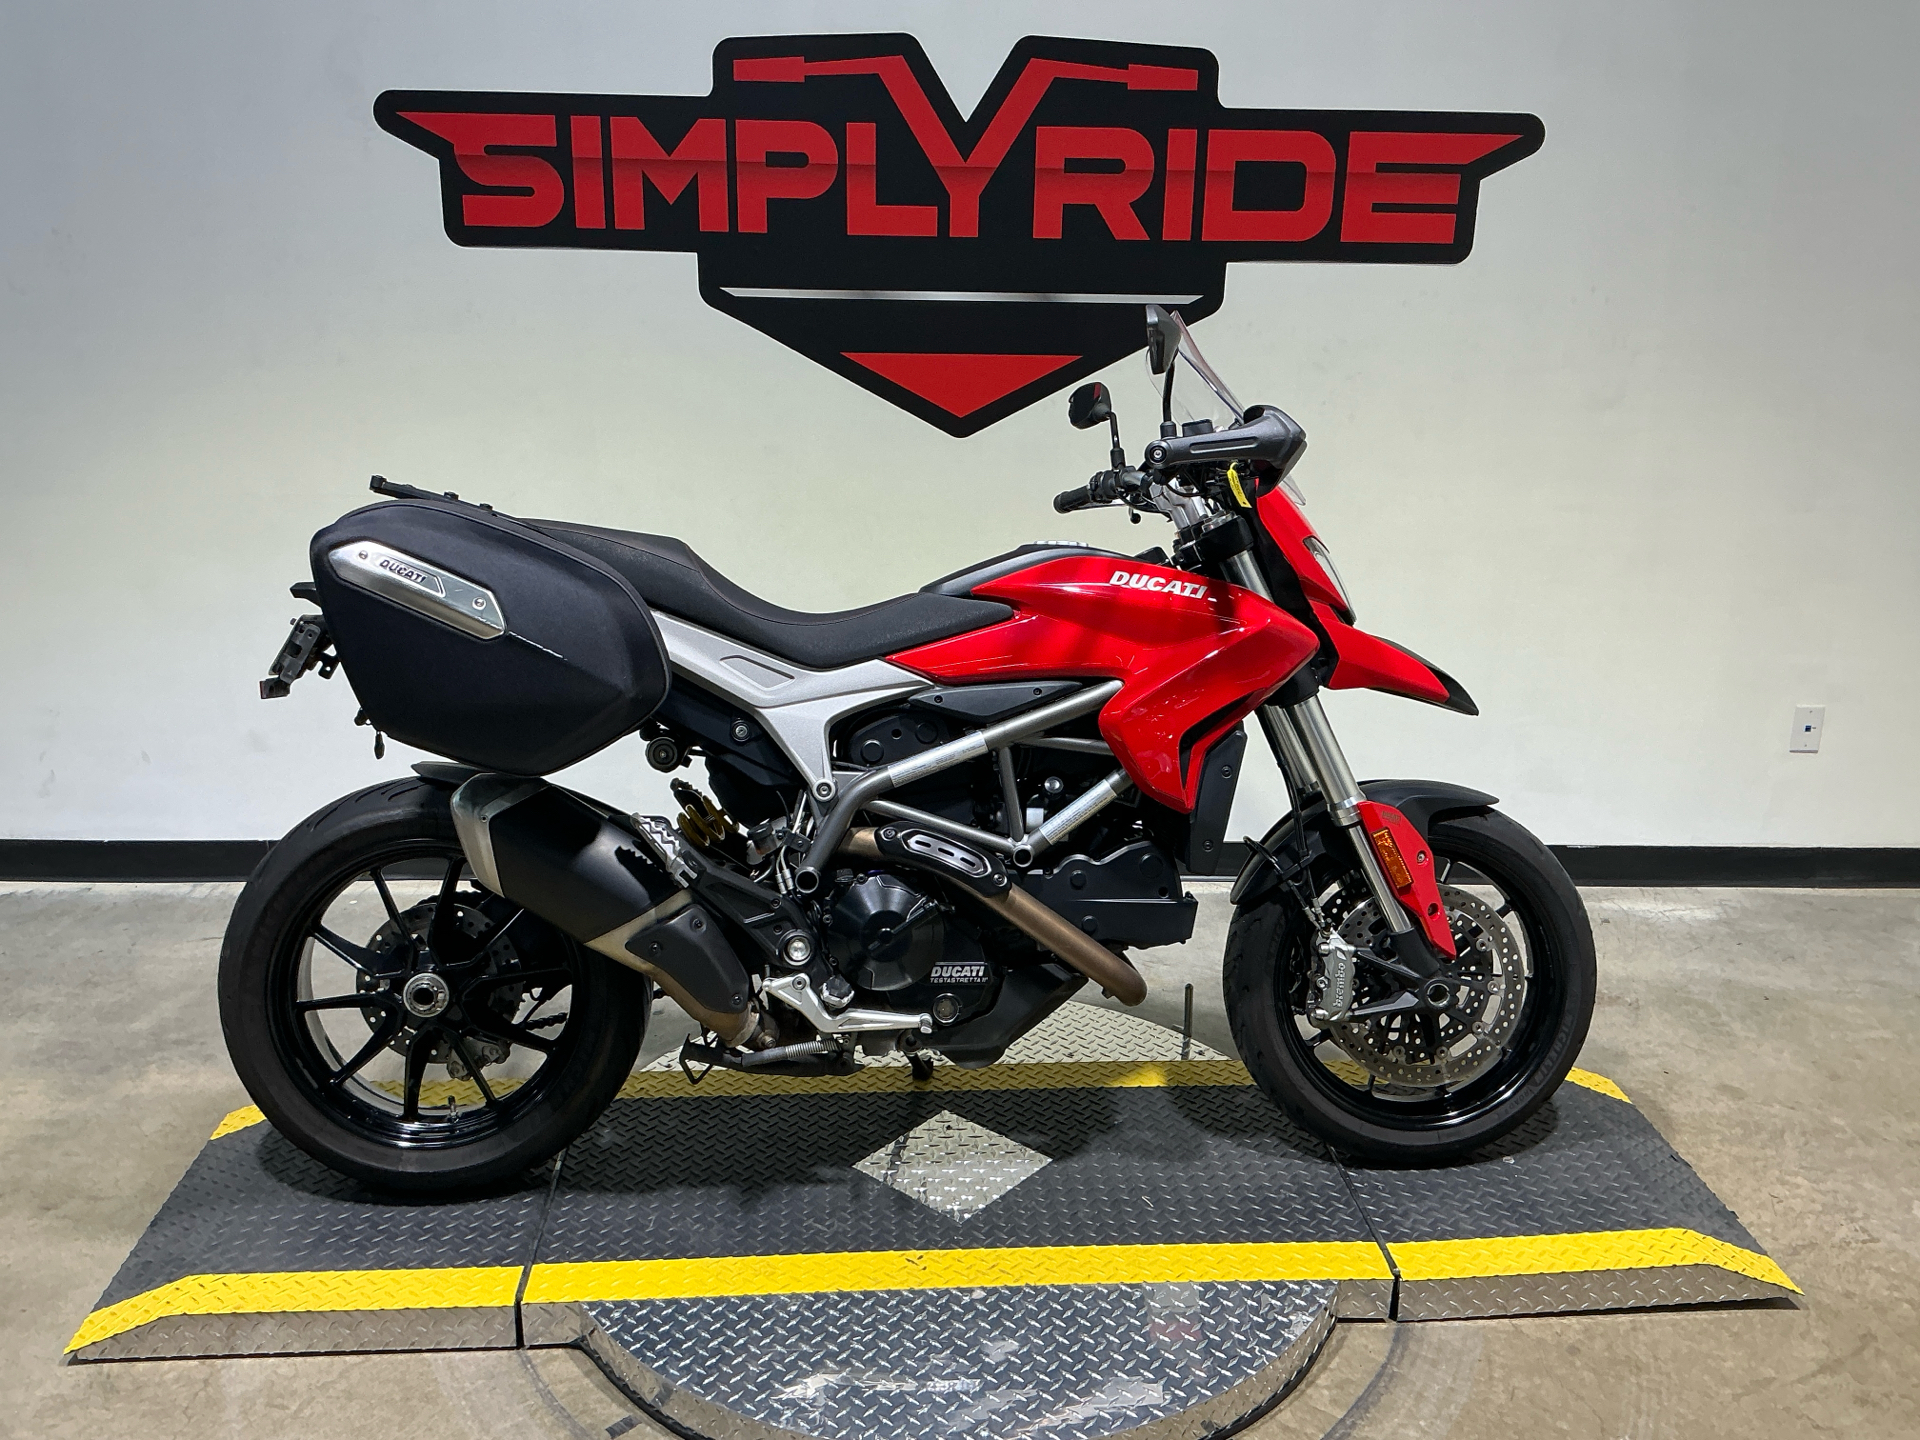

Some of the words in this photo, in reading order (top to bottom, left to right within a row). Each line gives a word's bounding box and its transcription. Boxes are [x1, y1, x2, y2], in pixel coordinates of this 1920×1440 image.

[379, 559, 427, 583] DUCATI
[1109, 570, 1208, 599] DUCATI
[930, 966, 985, 977] DUCATI
[1332, 962, 1346, 1008] brembo
